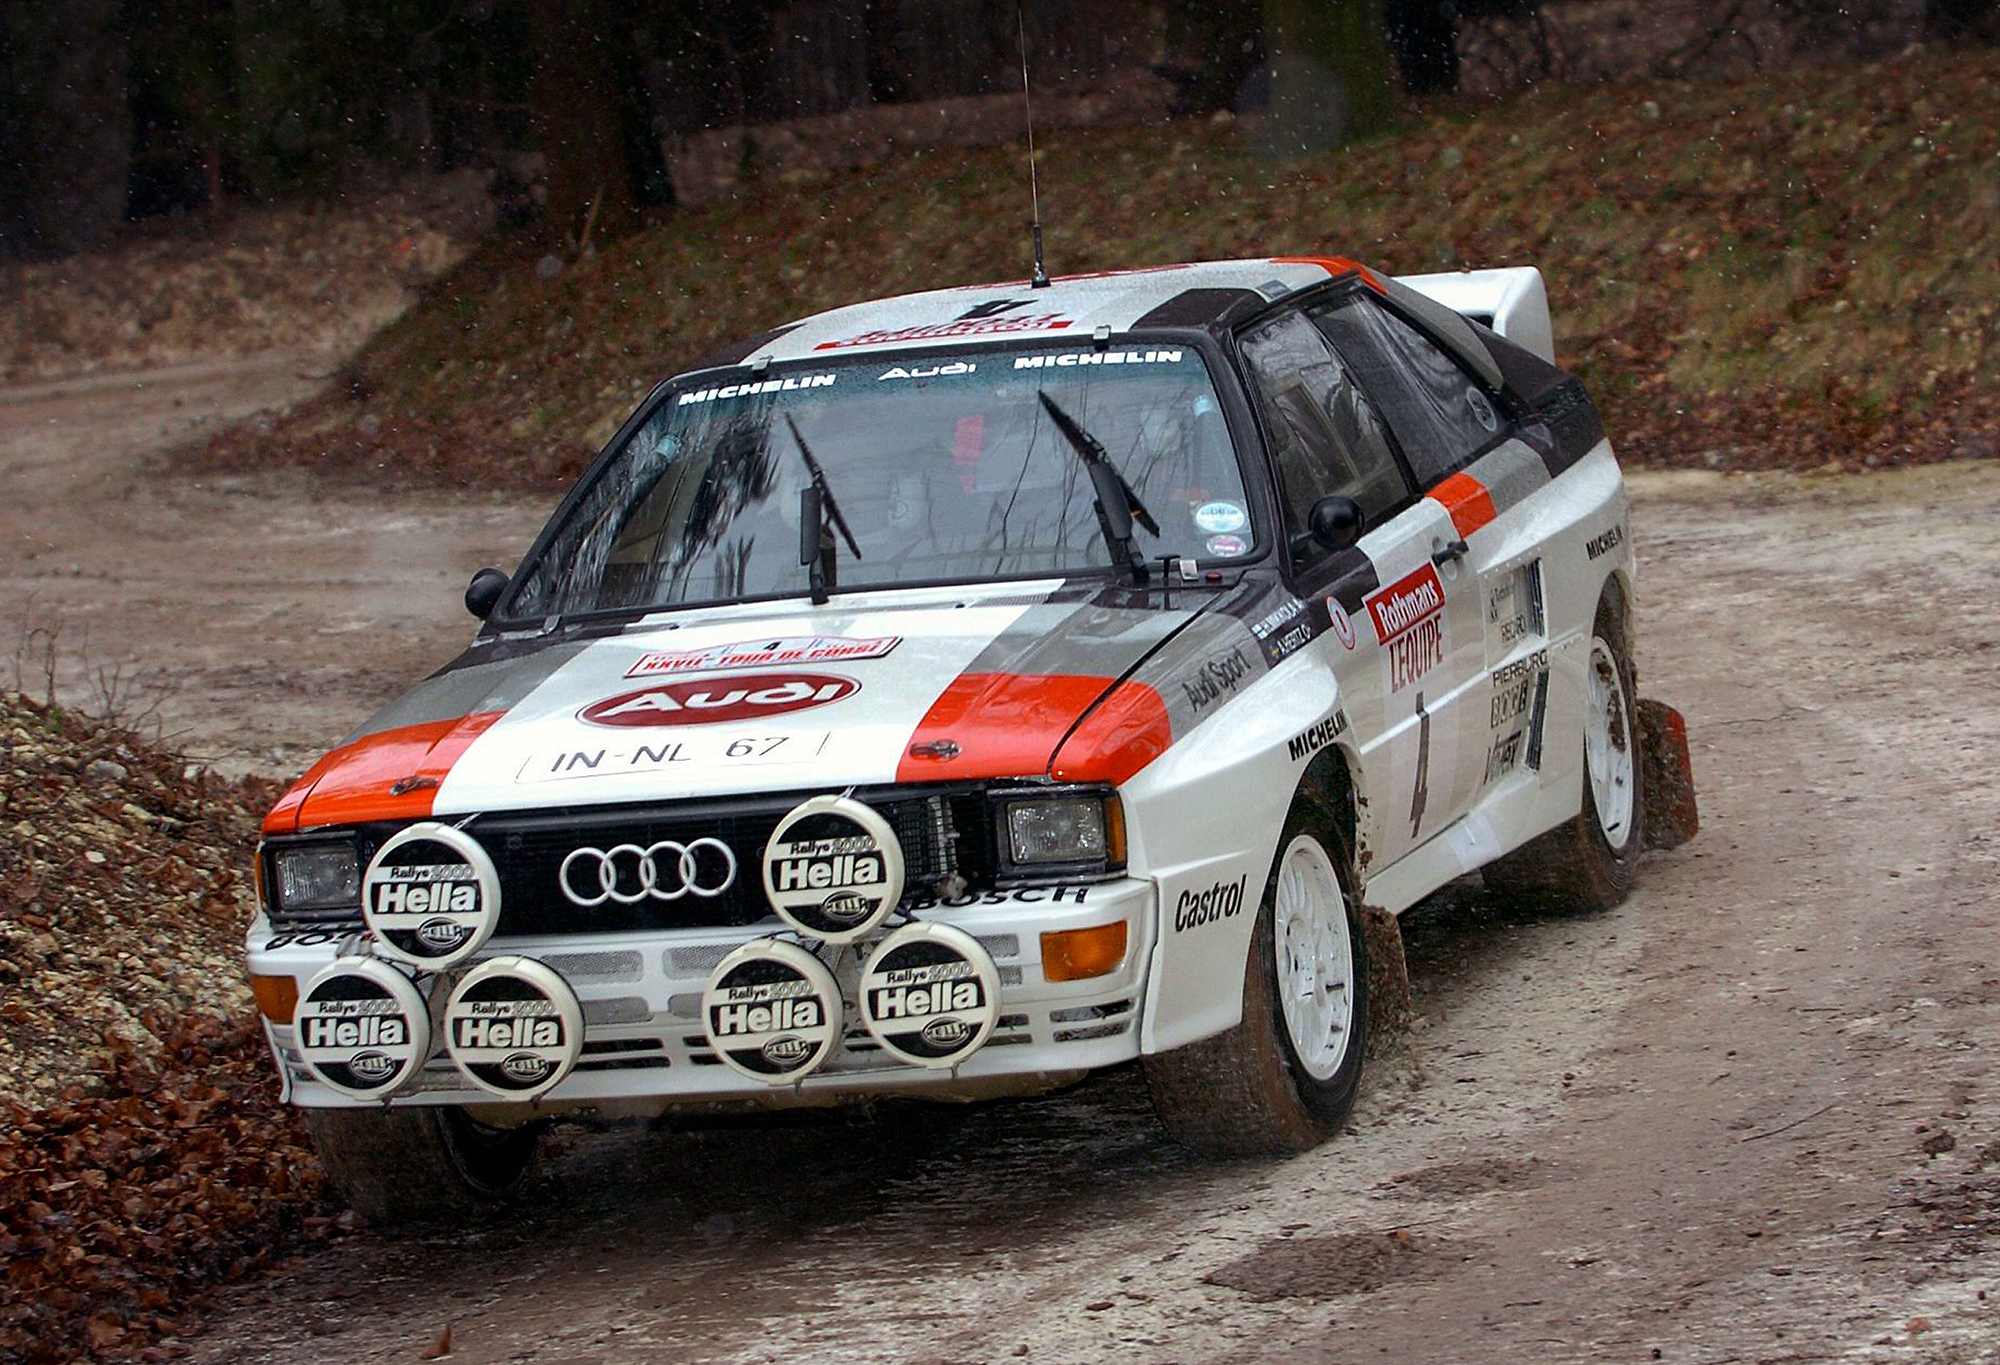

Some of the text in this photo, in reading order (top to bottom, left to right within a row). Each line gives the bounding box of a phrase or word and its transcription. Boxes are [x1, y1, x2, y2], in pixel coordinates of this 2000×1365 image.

[878, 362, 976, 381] Audi
[1014, 351, 1182, 369] MICHELIN
[679, 374, 836, 406] MICHELIN
[1375, 580, 1439, 636] Rothmans
[1208, 645, 1252, 691] Sport
[594, 682, 844, 717] Audi
[726, 737, 789, 757] 67
[1288, 709, 1347, 761] MICHELIN
[791, 841, 830, 856] Rallye
[390, 866, 430, 880] Rallye
[779, 855, 879, 890] Hella
[377, 882, 476, 913] Hella
[1175, 873, 1247, 932] Castrol
[887, 969, 927, 984] Rallye
[319, 1001, 356, 1015] Rallye
[729, 987, 768, 1000] Rallye
[877, 981, 978, 1020] Hella
[472, 1003, 510, 1016] Rallye
[719, 999, 818, 1035] Hella
[308, 1016, 404, 1046] Hella
[462, 1018, 559, 1047] Hella
